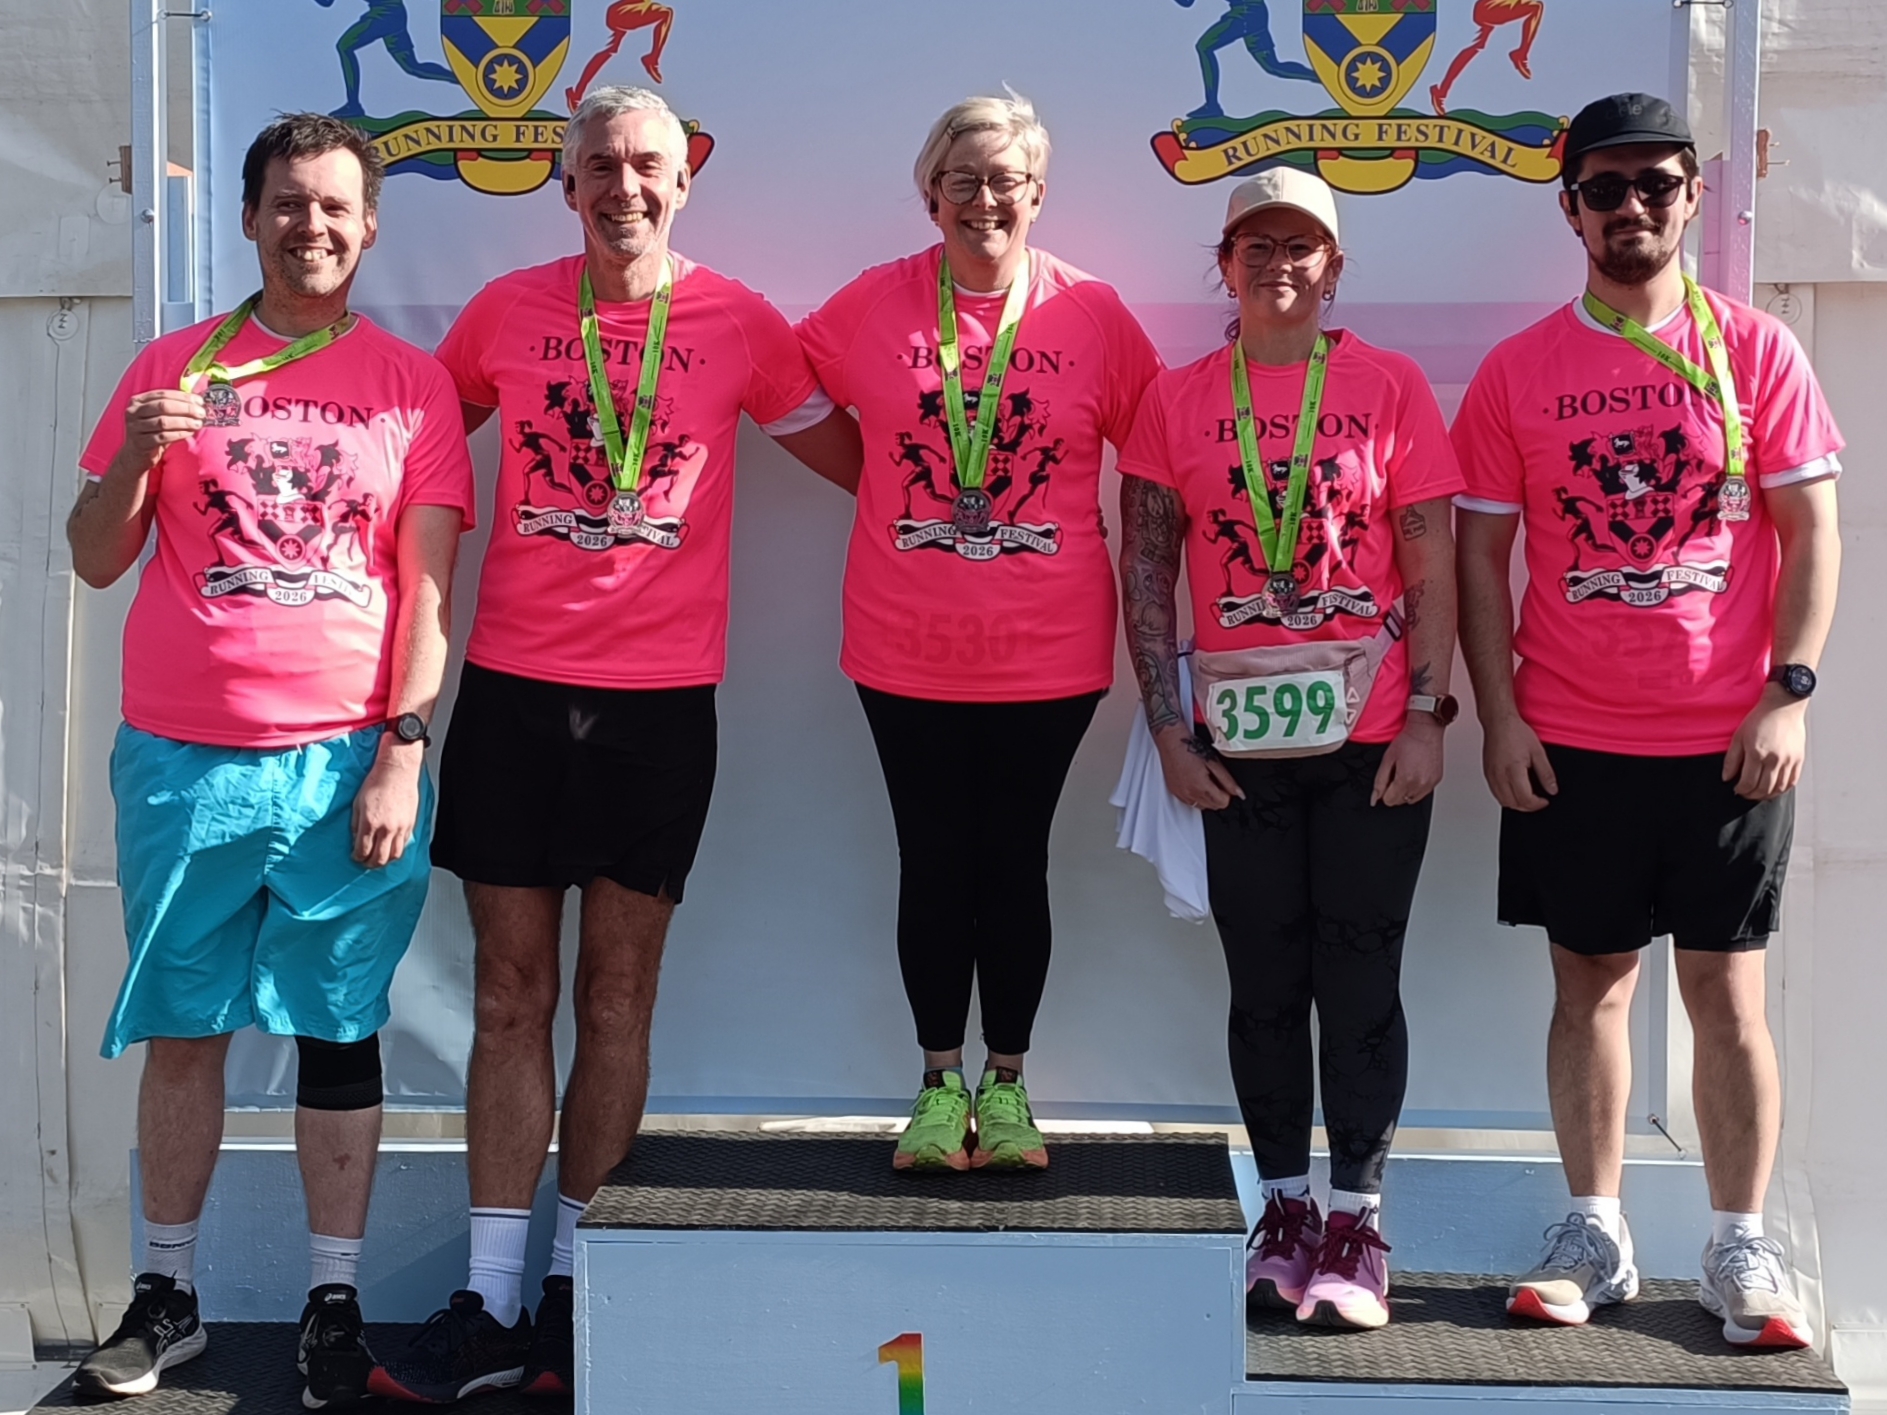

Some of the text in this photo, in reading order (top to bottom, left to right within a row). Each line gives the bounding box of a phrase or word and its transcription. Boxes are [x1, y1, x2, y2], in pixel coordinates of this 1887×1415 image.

[371, 123, 499, 158] UNNING
[1221, 122, 1518, 168] RUNNING FESTIVAL
[908, 345, 1062, 375] BSON
[243, 395, 374, 430] OSTON
[1555, 382, 1698, 421] BOSTO
[1215, 412, 1372, 443] BOSON
[523, 514, 573, 533] RUNNING
[577, 534, 608, 546] 2026
[902, 525, 1054, 553] RUNNING FESTIVAL
[963, 545, 994, 557] 2026
[210, 571, 268, 595] RUNNING
[275, 590, 307, 602] 2026
[1572, 570, 1723, 600] RUNNING FESTIVAL
[1628, 591, 1662, 603] 2026
[1227, 601, 1266, 625] RUNNI
[1287, 615, 1317, 627] 2026
[1216, 680, 1336, 741] 3599
[878, 1332, 925, 1415] 1
